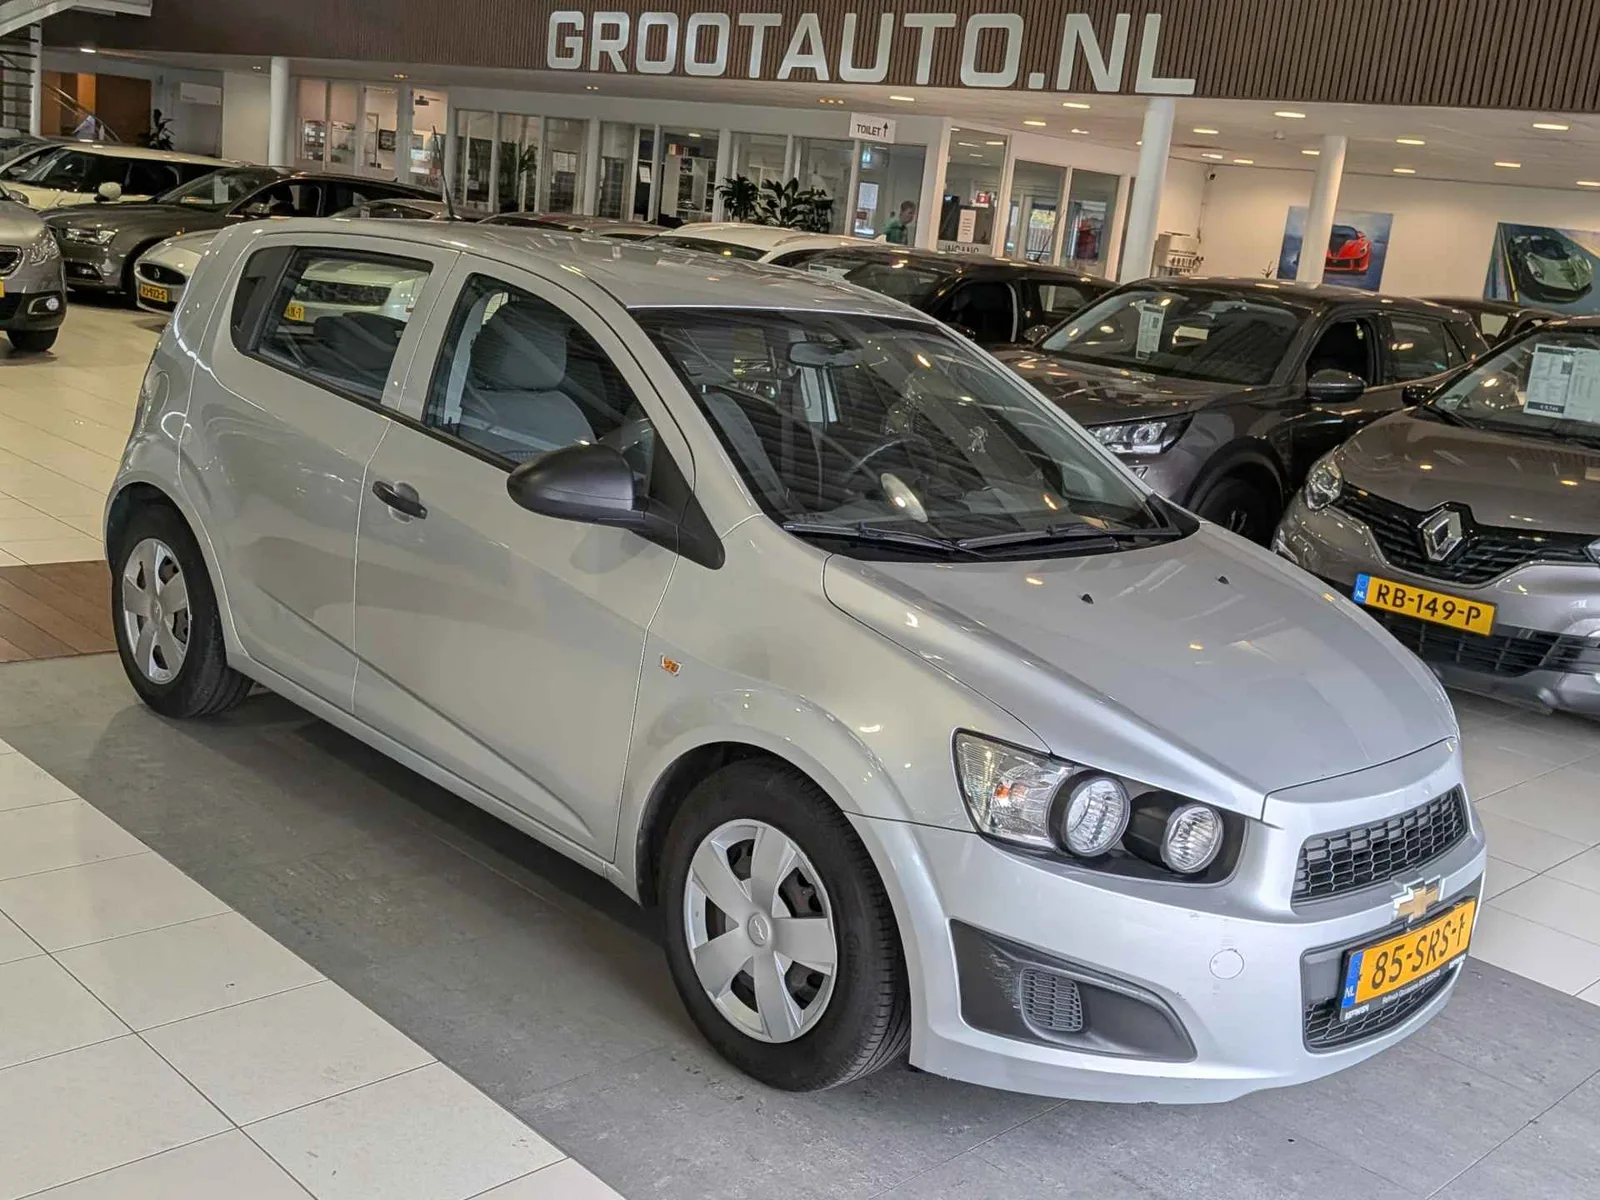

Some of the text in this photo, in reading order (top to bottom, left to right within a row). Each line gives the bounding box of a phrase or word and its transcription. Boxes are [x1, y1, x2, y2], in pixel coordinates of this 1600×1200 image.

[546, 11, 1195, 95] GROOTAUTO.NL
[856, 123, 882, 137] TOILET
[1376, 582, 1481, 626] RB-149-P
[1343, 985, 1355, 1000] NL
